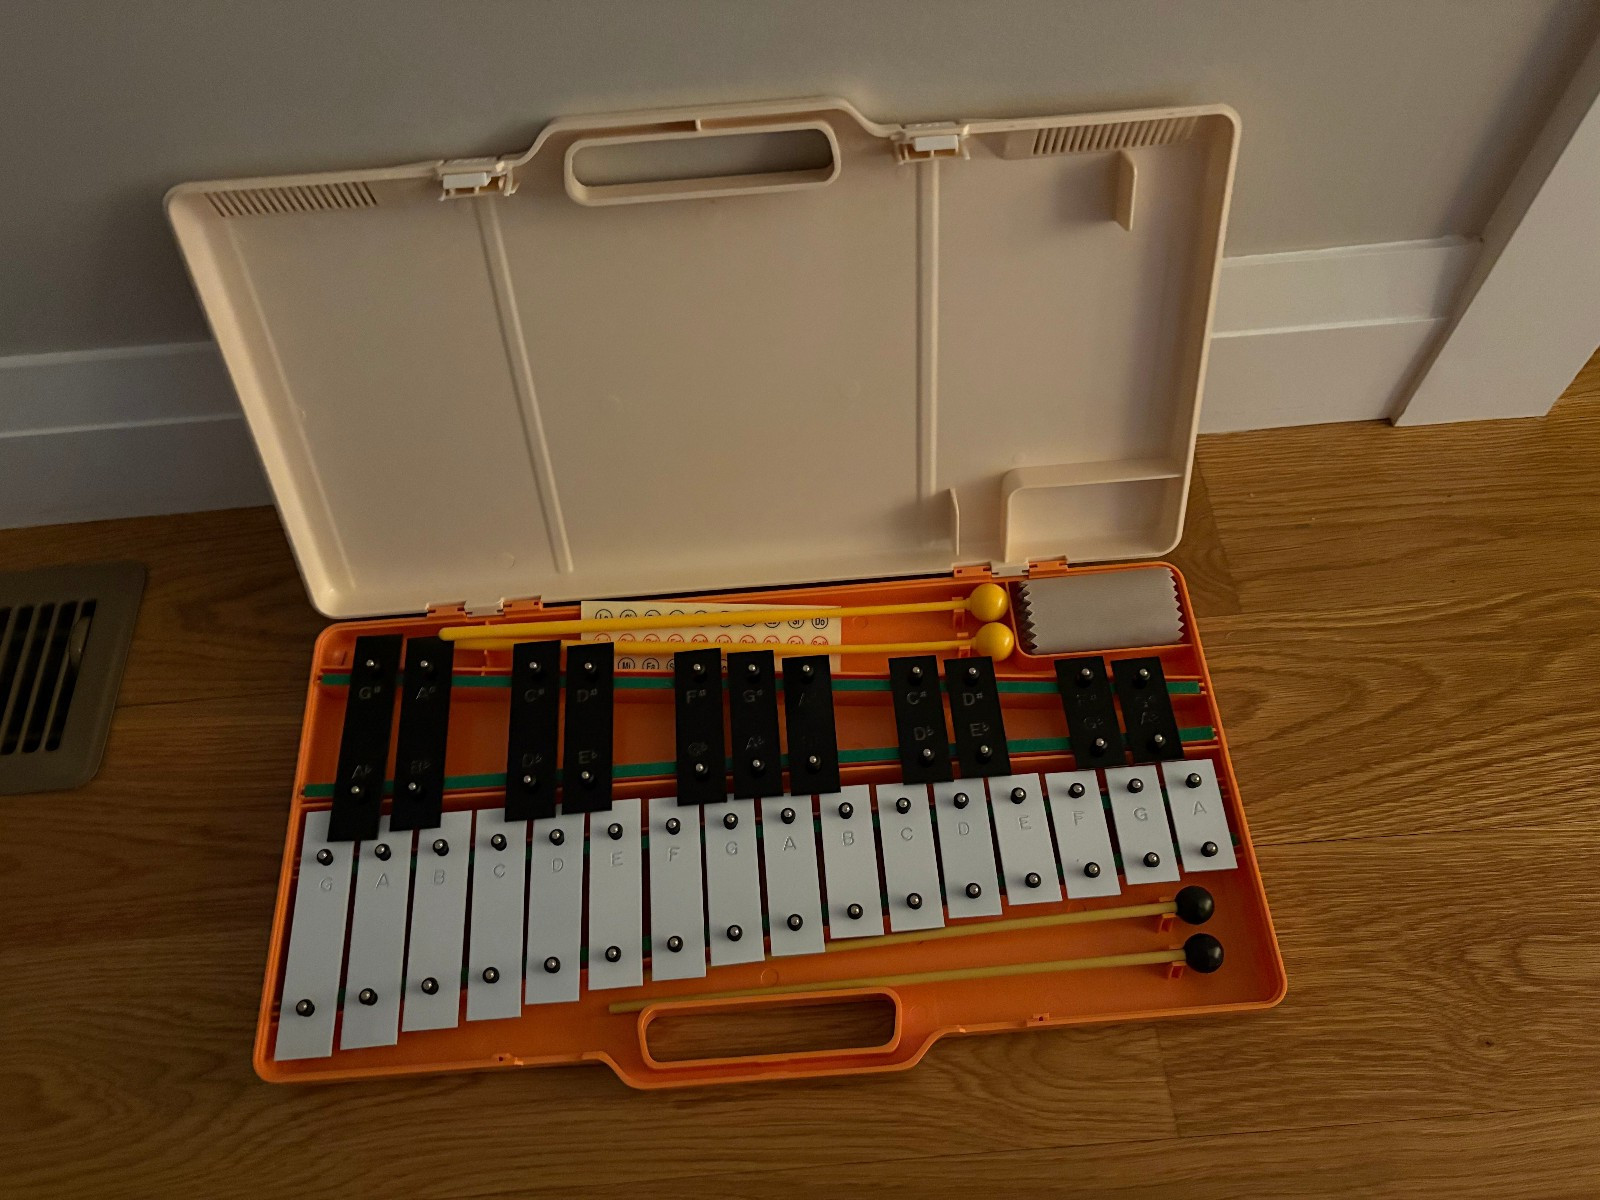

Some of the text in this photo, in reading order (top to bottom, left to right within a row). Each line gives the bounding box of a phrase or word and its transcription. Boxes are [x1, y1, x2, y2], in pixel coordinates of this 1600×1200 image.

[906, 691, 927, 705] C#
[962, 692, 984, 706] D#
[1133, 807, 1148, 821] G
[1193, 800, 1207, 815] A
[1019, 815, 1032, 831] E
[1073, 810, 1085, 826] F
[901, 827, 913, 841] C
[958, 822, 970, 835] D
[783, 836, 796, 851] A
[841, 831, 854, 846] B
[669, 846, 680, 862] F
[725, 841, 738, 855] G
[552, 858, 564, 872] D
[610, 851, 623, 867] E
[433, 869, 445, 885] B
[493, 863, 506, 878] C
[320, 877, 333, 891] G
[375, 872, 389, 889] A
